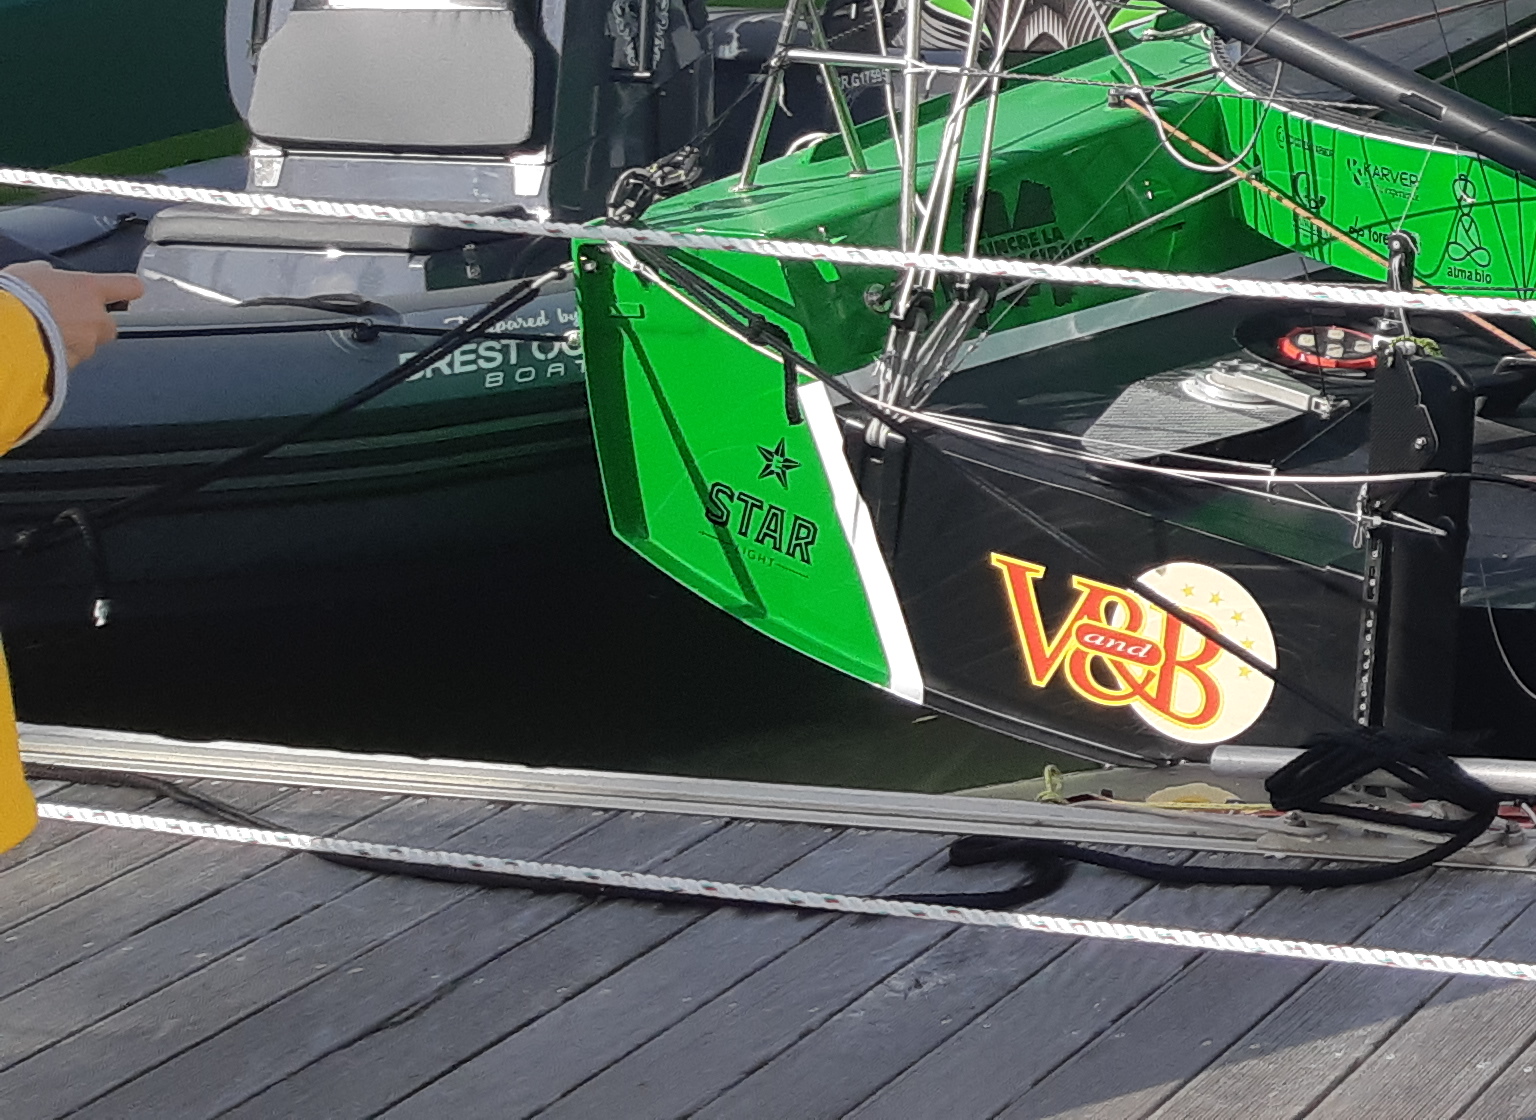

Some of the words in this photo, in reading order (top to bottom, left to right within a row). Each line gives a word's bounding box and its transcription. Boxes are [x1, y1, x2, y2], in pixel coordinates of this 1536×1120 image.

[1363, 163, 1419, 189] KARVER
[705, 482, 819, 566] STAR
[742, 545, 775, 567] IGHT
[1083, 632, 1153, 659] and
